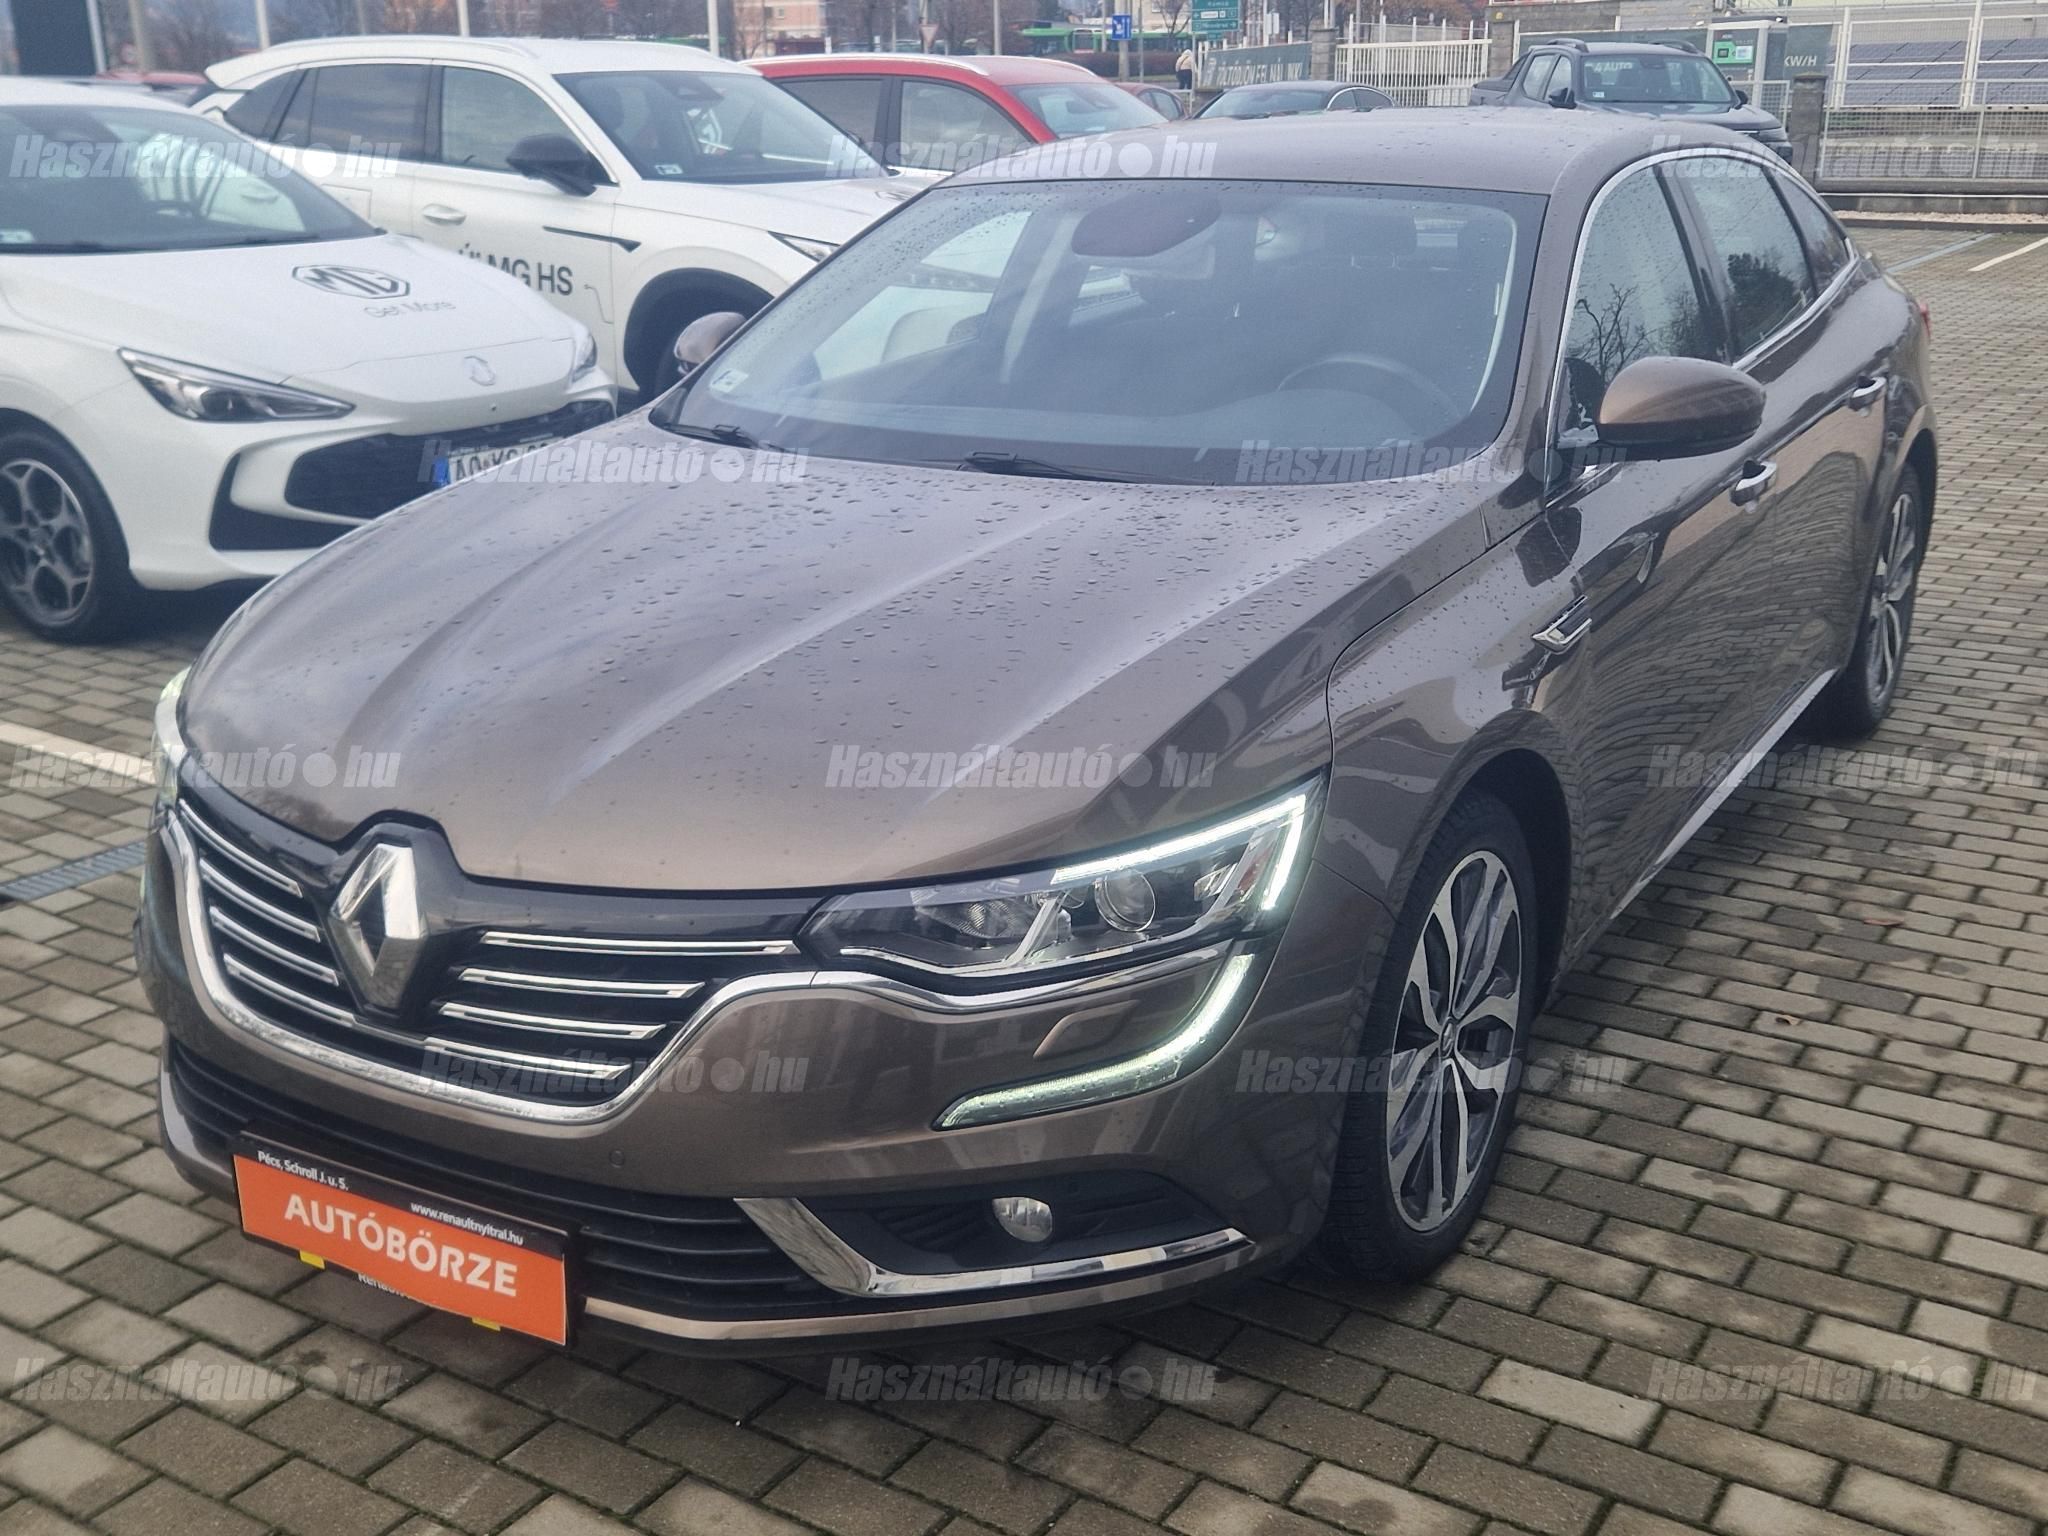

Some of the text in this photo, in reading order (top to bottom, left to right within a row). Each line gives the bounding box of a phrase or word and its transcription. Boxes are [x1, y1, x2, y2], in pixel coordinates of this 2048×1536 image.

[537, 262, 574, 296] HS
[257, 1150, 284, 1171] Pécs,
[284, 1159, 318, 1181] Schroll
[284, 1193, 518, 1297] AUTÓBÖRZE
